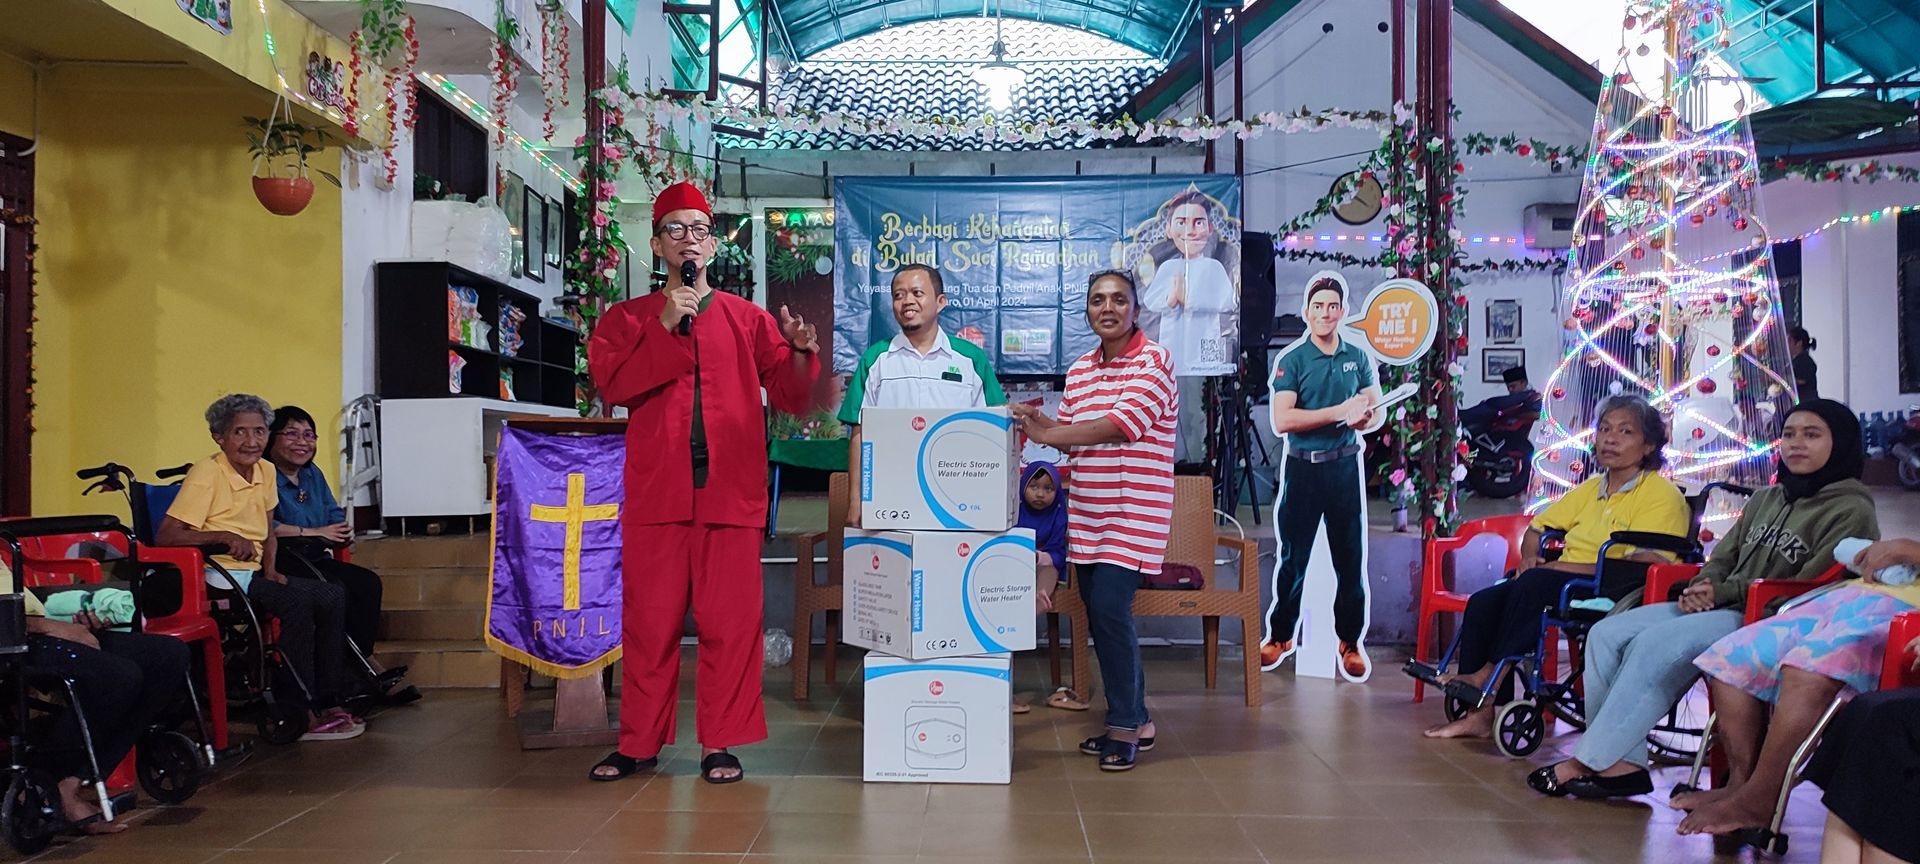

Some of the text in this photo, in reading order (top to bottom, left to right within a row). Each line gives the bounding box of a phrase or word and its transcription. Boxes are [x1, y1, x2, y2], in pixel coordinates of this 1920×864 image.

[783, 212, 834, 226] YAYAS
[879, 212, 1071, 244] Berbagi Kehangatan
[851, 241, 1102, 272] di Bulan Suci Ramadhan
[858, 283, 892, 294] Yayasa
[963, 284, 979, 293] Tua
[982, 283, 1001, 293] dan
[1003, 283, 1034, 293] Peduli
[1036, 283, 1062, 293] Anak
[963, 297, 975, 306] 01
[977, 297, 999, 308] April
[1001, 297, 1027, 306] 2024
[1379, 301, 1413, 320] TRY
[1379, 319, 1405, 335] ME
[863, 444, 871, 499] Water Heater
[969, 461, 1000, 470] Storage
[1006, 584, 1031, 593] Storage
[913, 572, 921, 630] Water Heater
[980, 594, 1022, 603] Water Heater
[533, 615, 611, 640] PNIL
